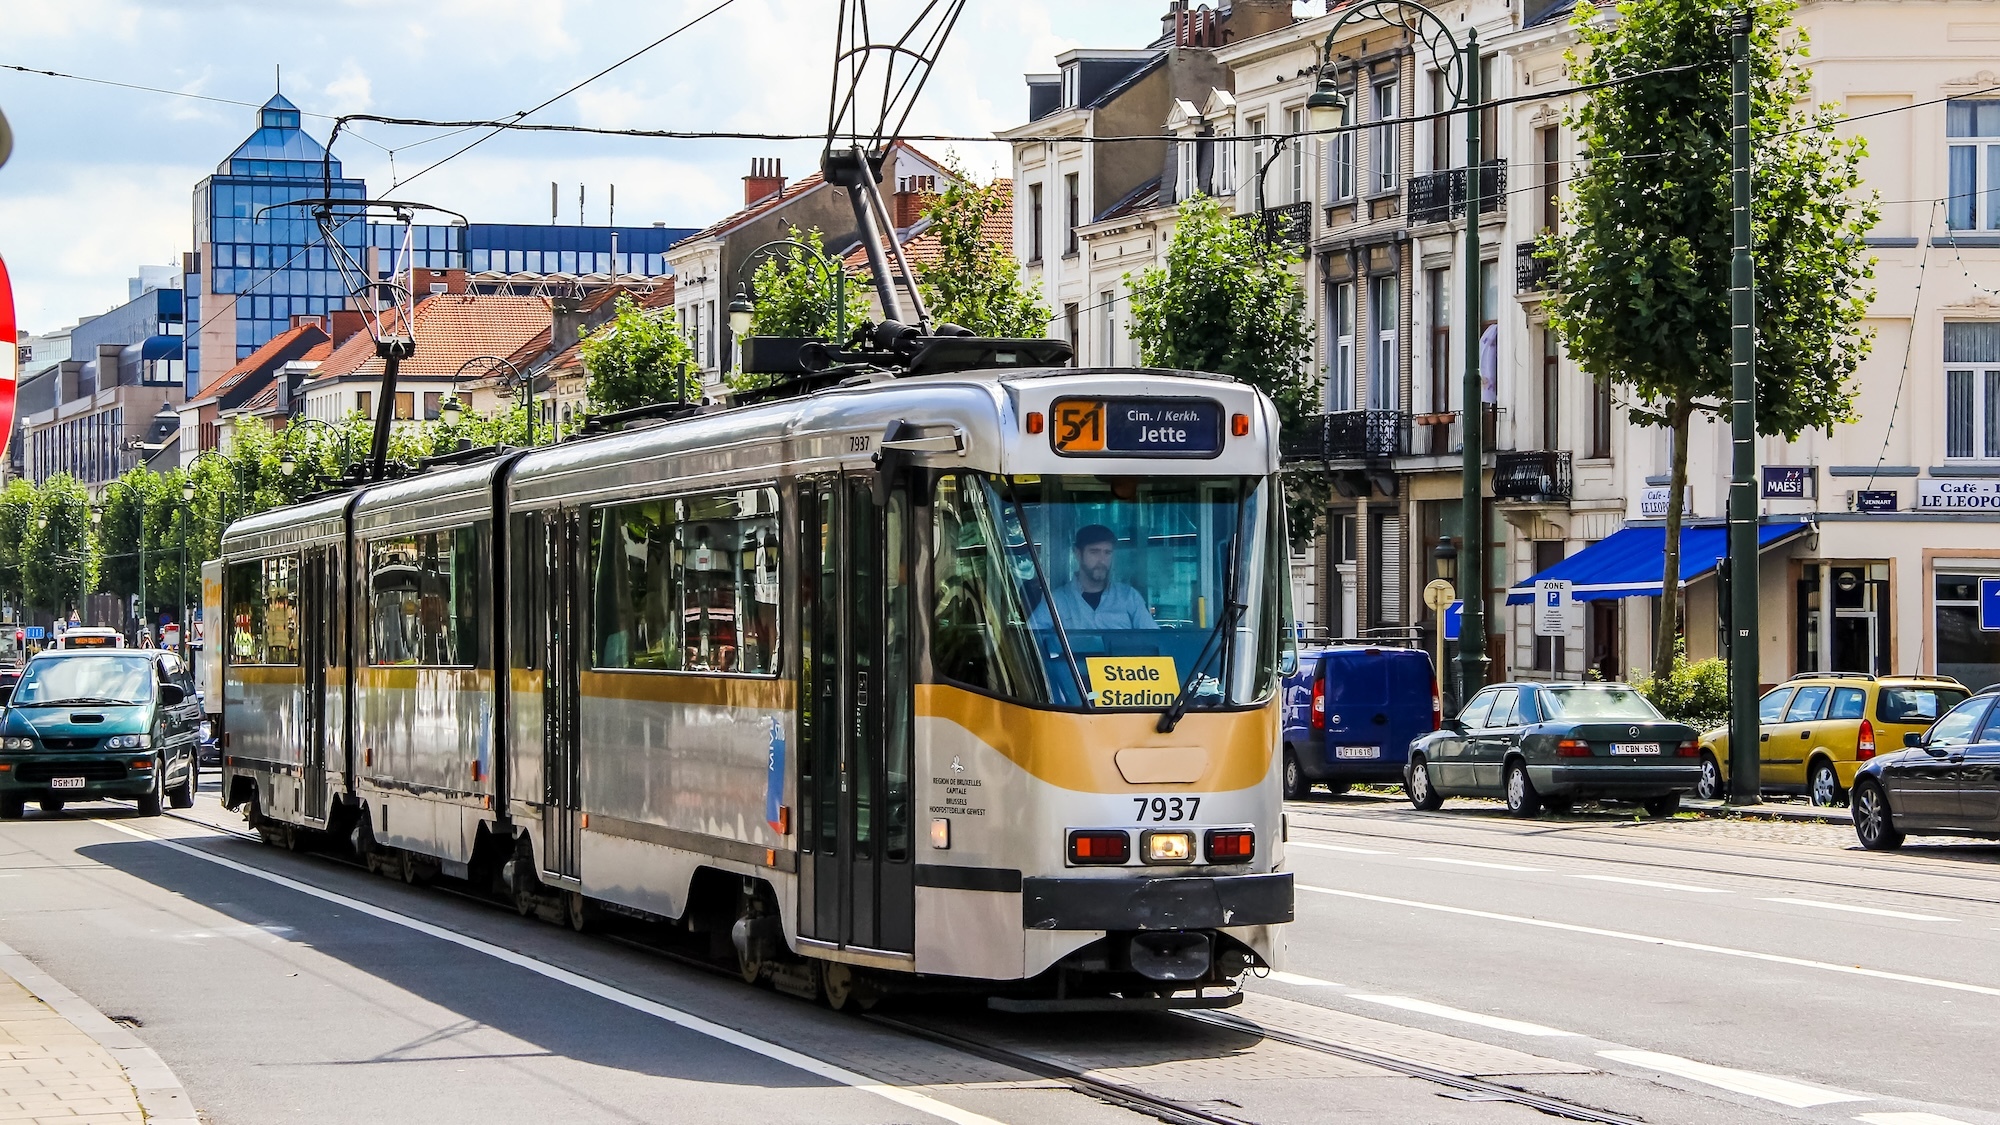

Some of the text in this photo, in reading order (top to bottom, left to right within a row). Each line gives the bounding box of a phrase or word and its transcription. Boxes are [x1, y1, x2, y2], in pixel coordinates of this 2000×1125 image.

[1127, 410, 1153, 421] Cim.
[1164, 410, 1200, 421] Kerkh.
[1062, 408, 1099, 442] 51
[1138, 426, 1187, 443] Jette
[850, 435, 870, 451] 7937
[1767, 481, 1797, 492] MAES
[1940, 483, 1977, 493] Café
[1648, 491, 1661, 499] Café
[1922, 496, 1942, 506] LE
[1642, 503, 1650, 512] LE
[1104, 665, 1160, 681] Stade
[1102, 689, 1175, 706] Stadion
[950, 778, 956, 786] DE
[1133, 797, 1201, 822] 7937
